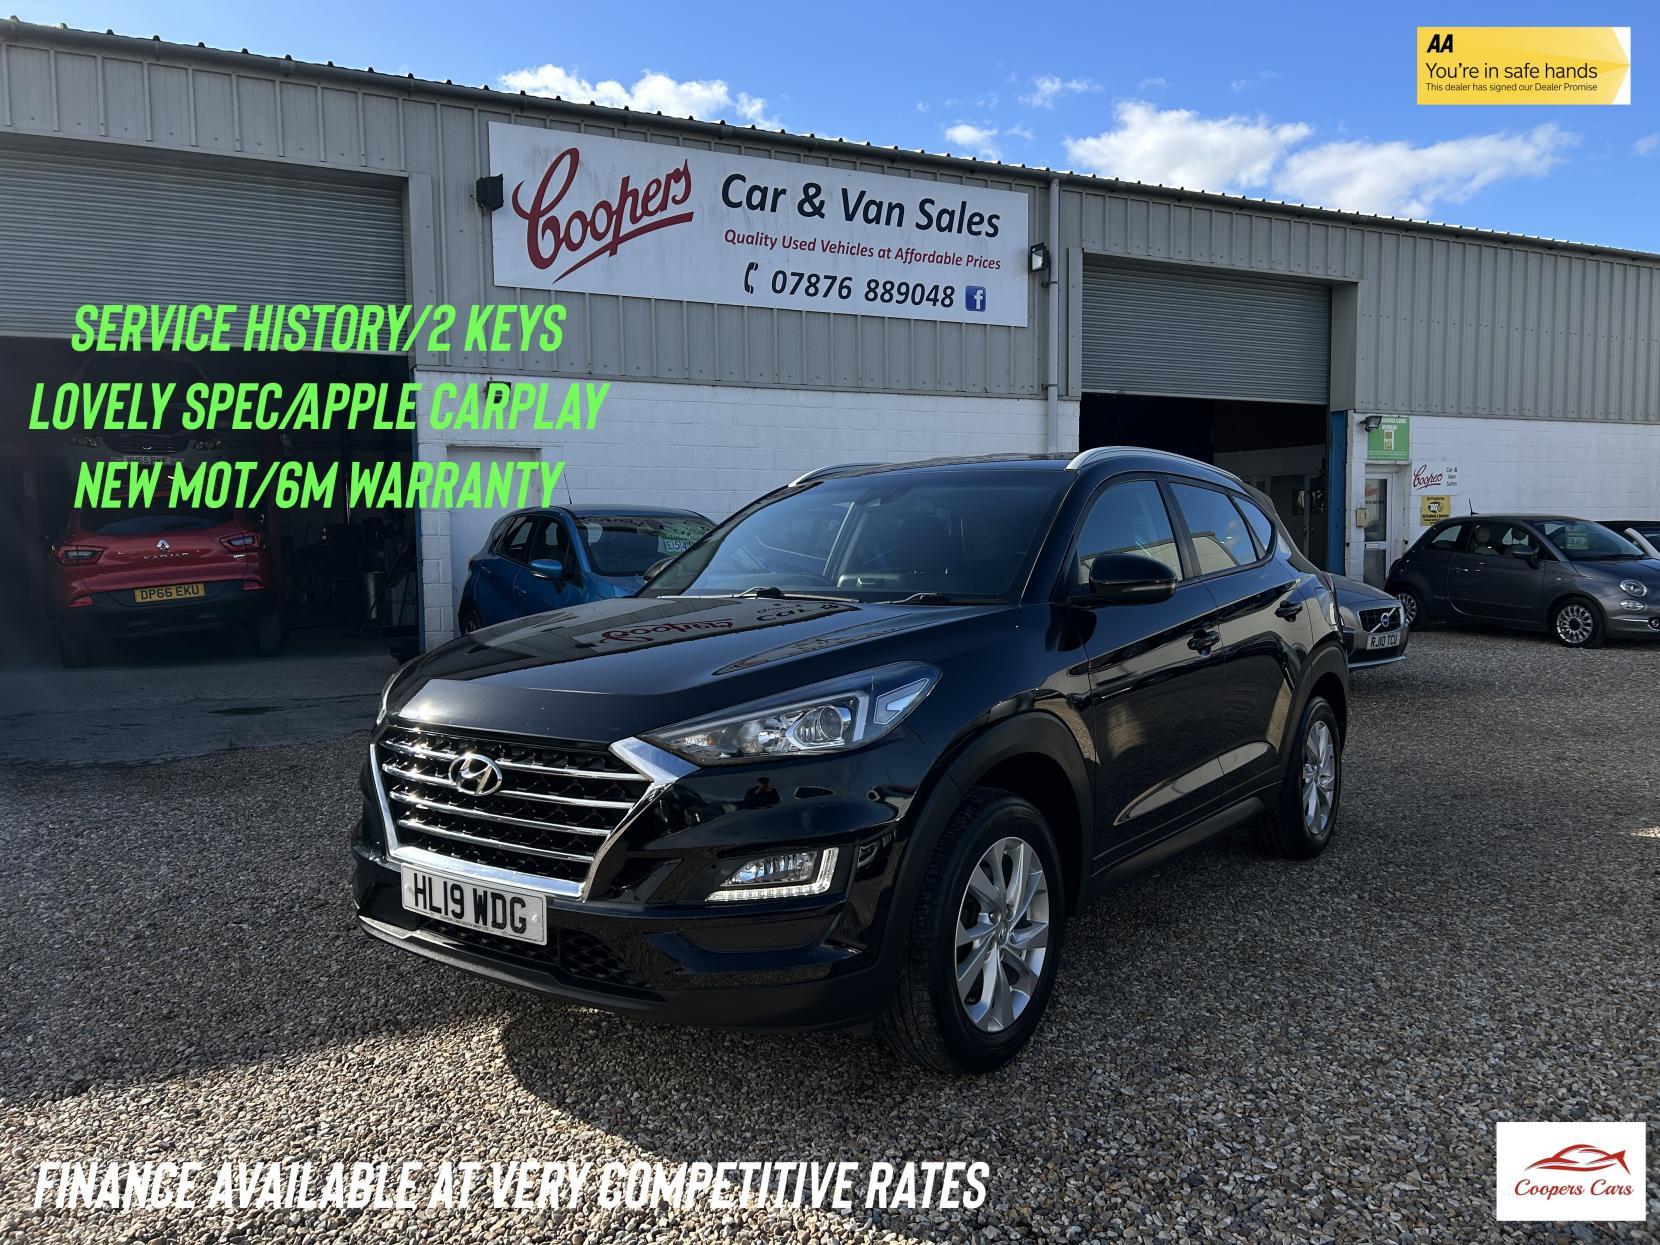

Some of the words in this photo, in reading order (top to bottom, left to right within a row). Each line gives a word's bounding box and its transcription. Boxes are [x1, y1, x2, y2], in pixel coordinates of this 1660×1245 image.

[511, 147, 695, 285] Coopers
[721, 173, 787, 213] Car
[797, 182, 826, 219] &
[841, 187, 905, 228] Van
[915, 198, 1001, 238] Sales
[724, 229, 778, 250] Quality
[781, 235, 816, 251] Used
[820, 239, 874, 258] Vehicles
[877, 246, 892, 260] at
[894, 247, 963, 266] Affordable
[965, 254, 1001, 270] Prices
[771, 270, 853, 300] 07876
[864, 278, 955, 308] 889048
[140, 587, 173, 600] DP66
[175, 584, 200, 597] EKU
[413, 872, 465, 920] HL19
[472, 887, 527, 935] WDG
